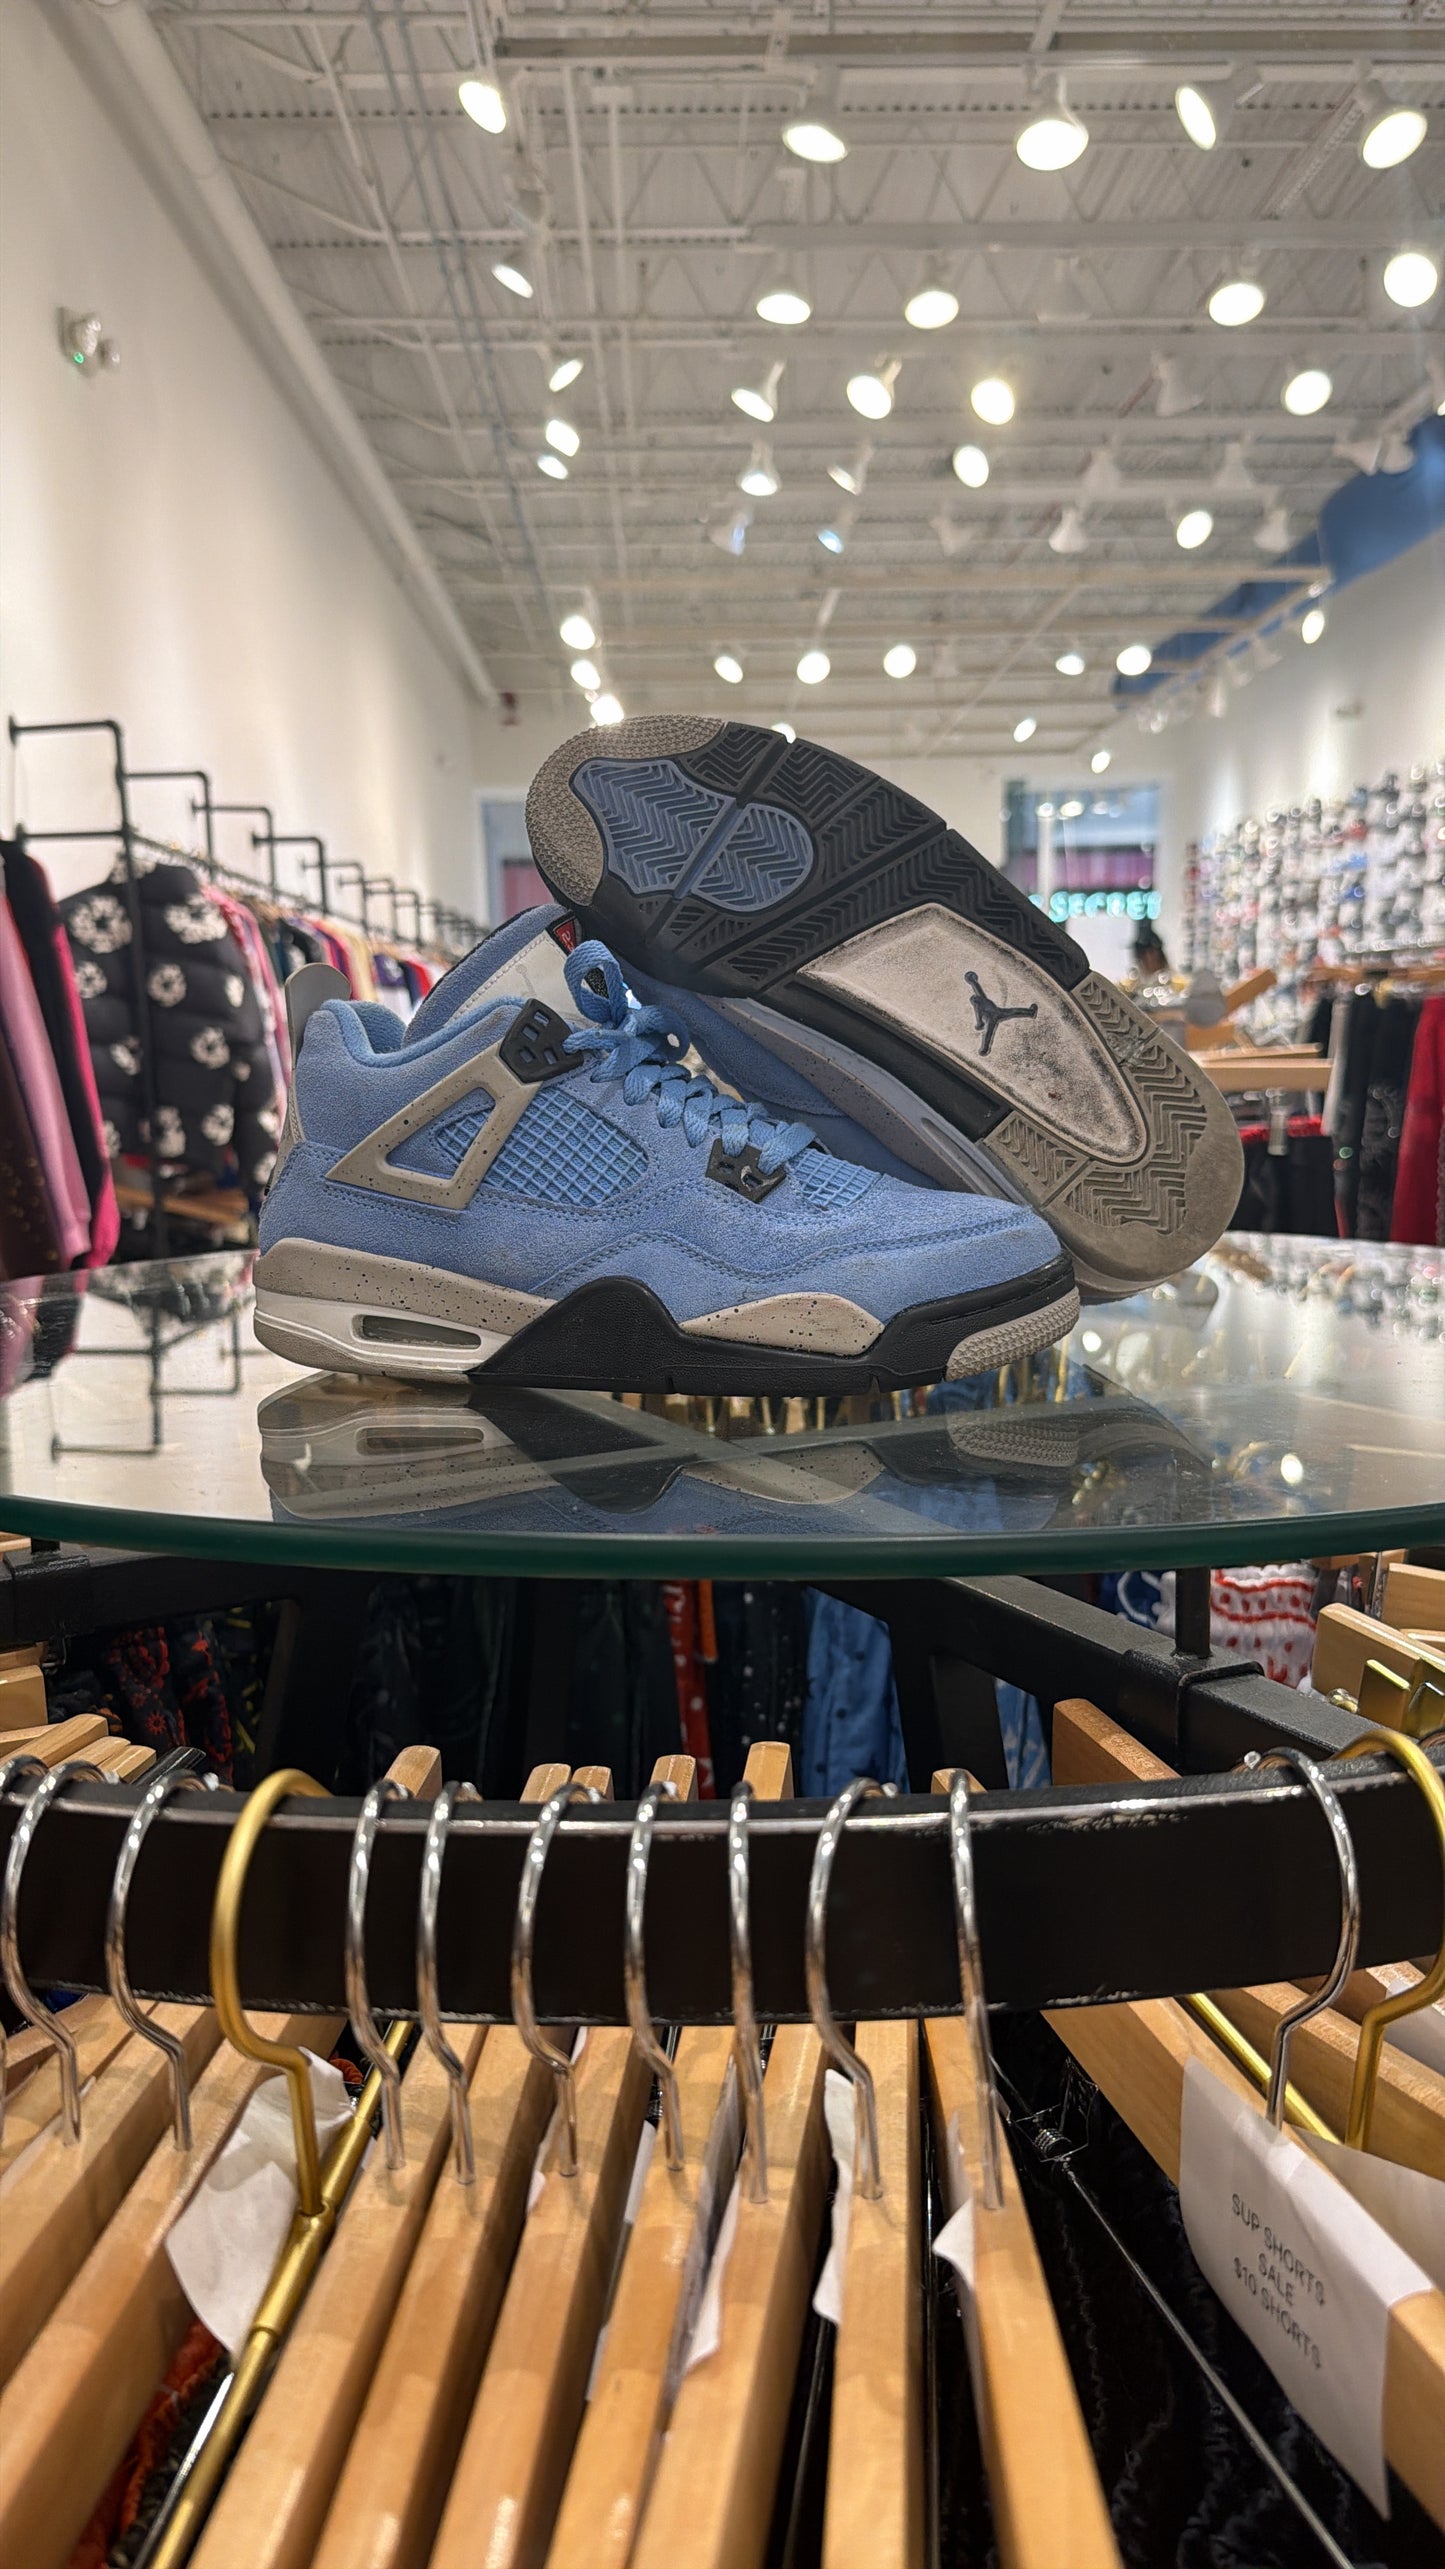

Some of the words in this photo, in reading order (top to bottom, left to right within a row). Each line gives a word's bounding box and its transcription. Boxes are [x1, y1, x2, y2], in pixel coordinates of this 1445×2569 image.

[1232, 2193, 1260, 2231] SUP
[1264, 2227, 1325, 2306] SHORTS
[1258, 2253, 1294, 2306] SALE
[1234, 2257, 1258, 2296] $10
[1261, 2287, 1322, 2369] SHORTS
